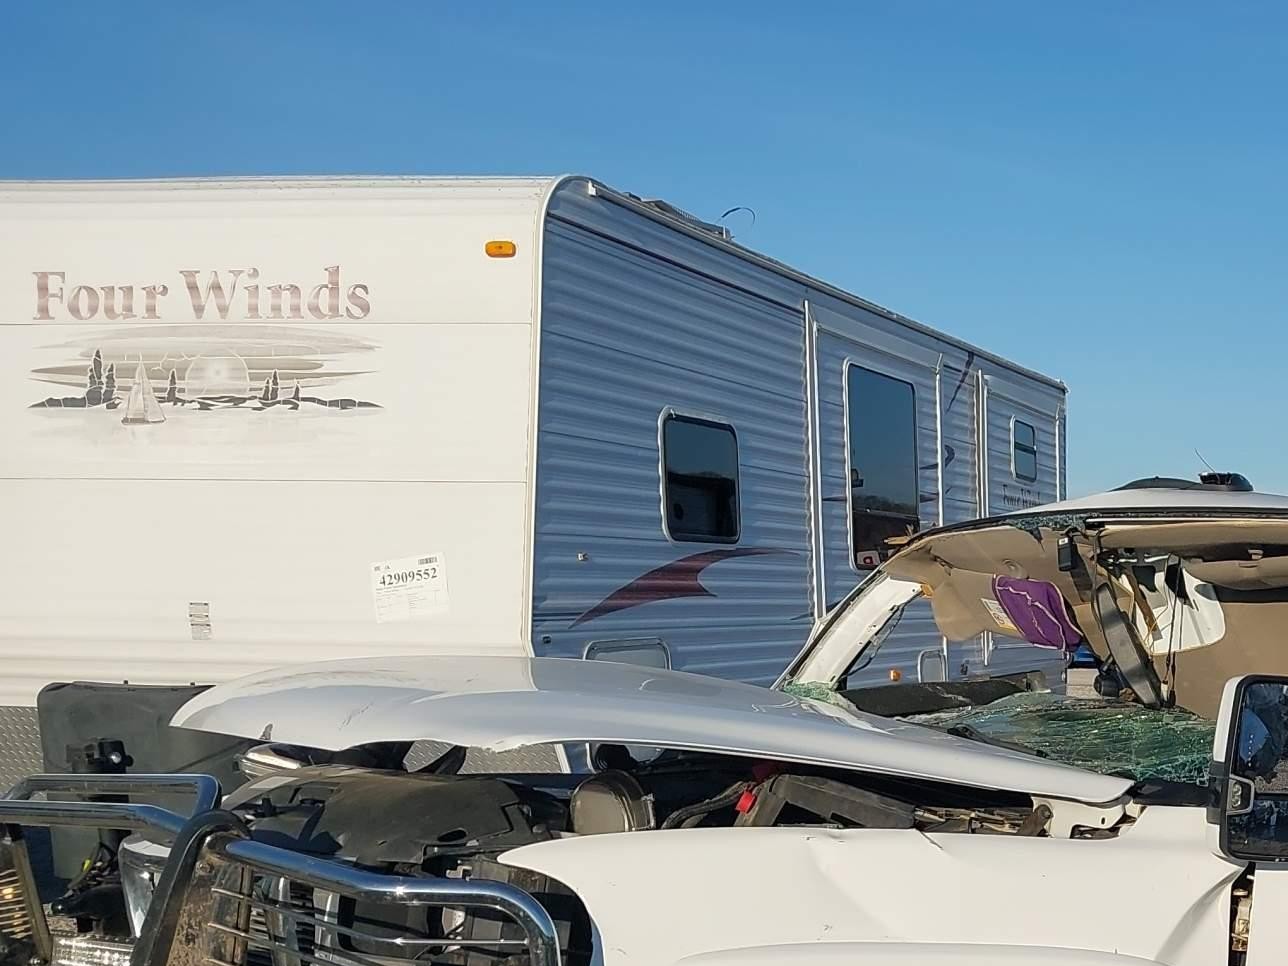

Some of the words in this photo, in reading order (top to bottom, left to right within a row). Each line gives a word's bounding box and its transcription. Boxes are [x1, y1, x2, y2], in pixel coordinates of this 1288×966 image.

[32, 271, 169, 321] Four
[178, 265, 372, 321] Winds
[379, 567, 438, 586] 42909552
